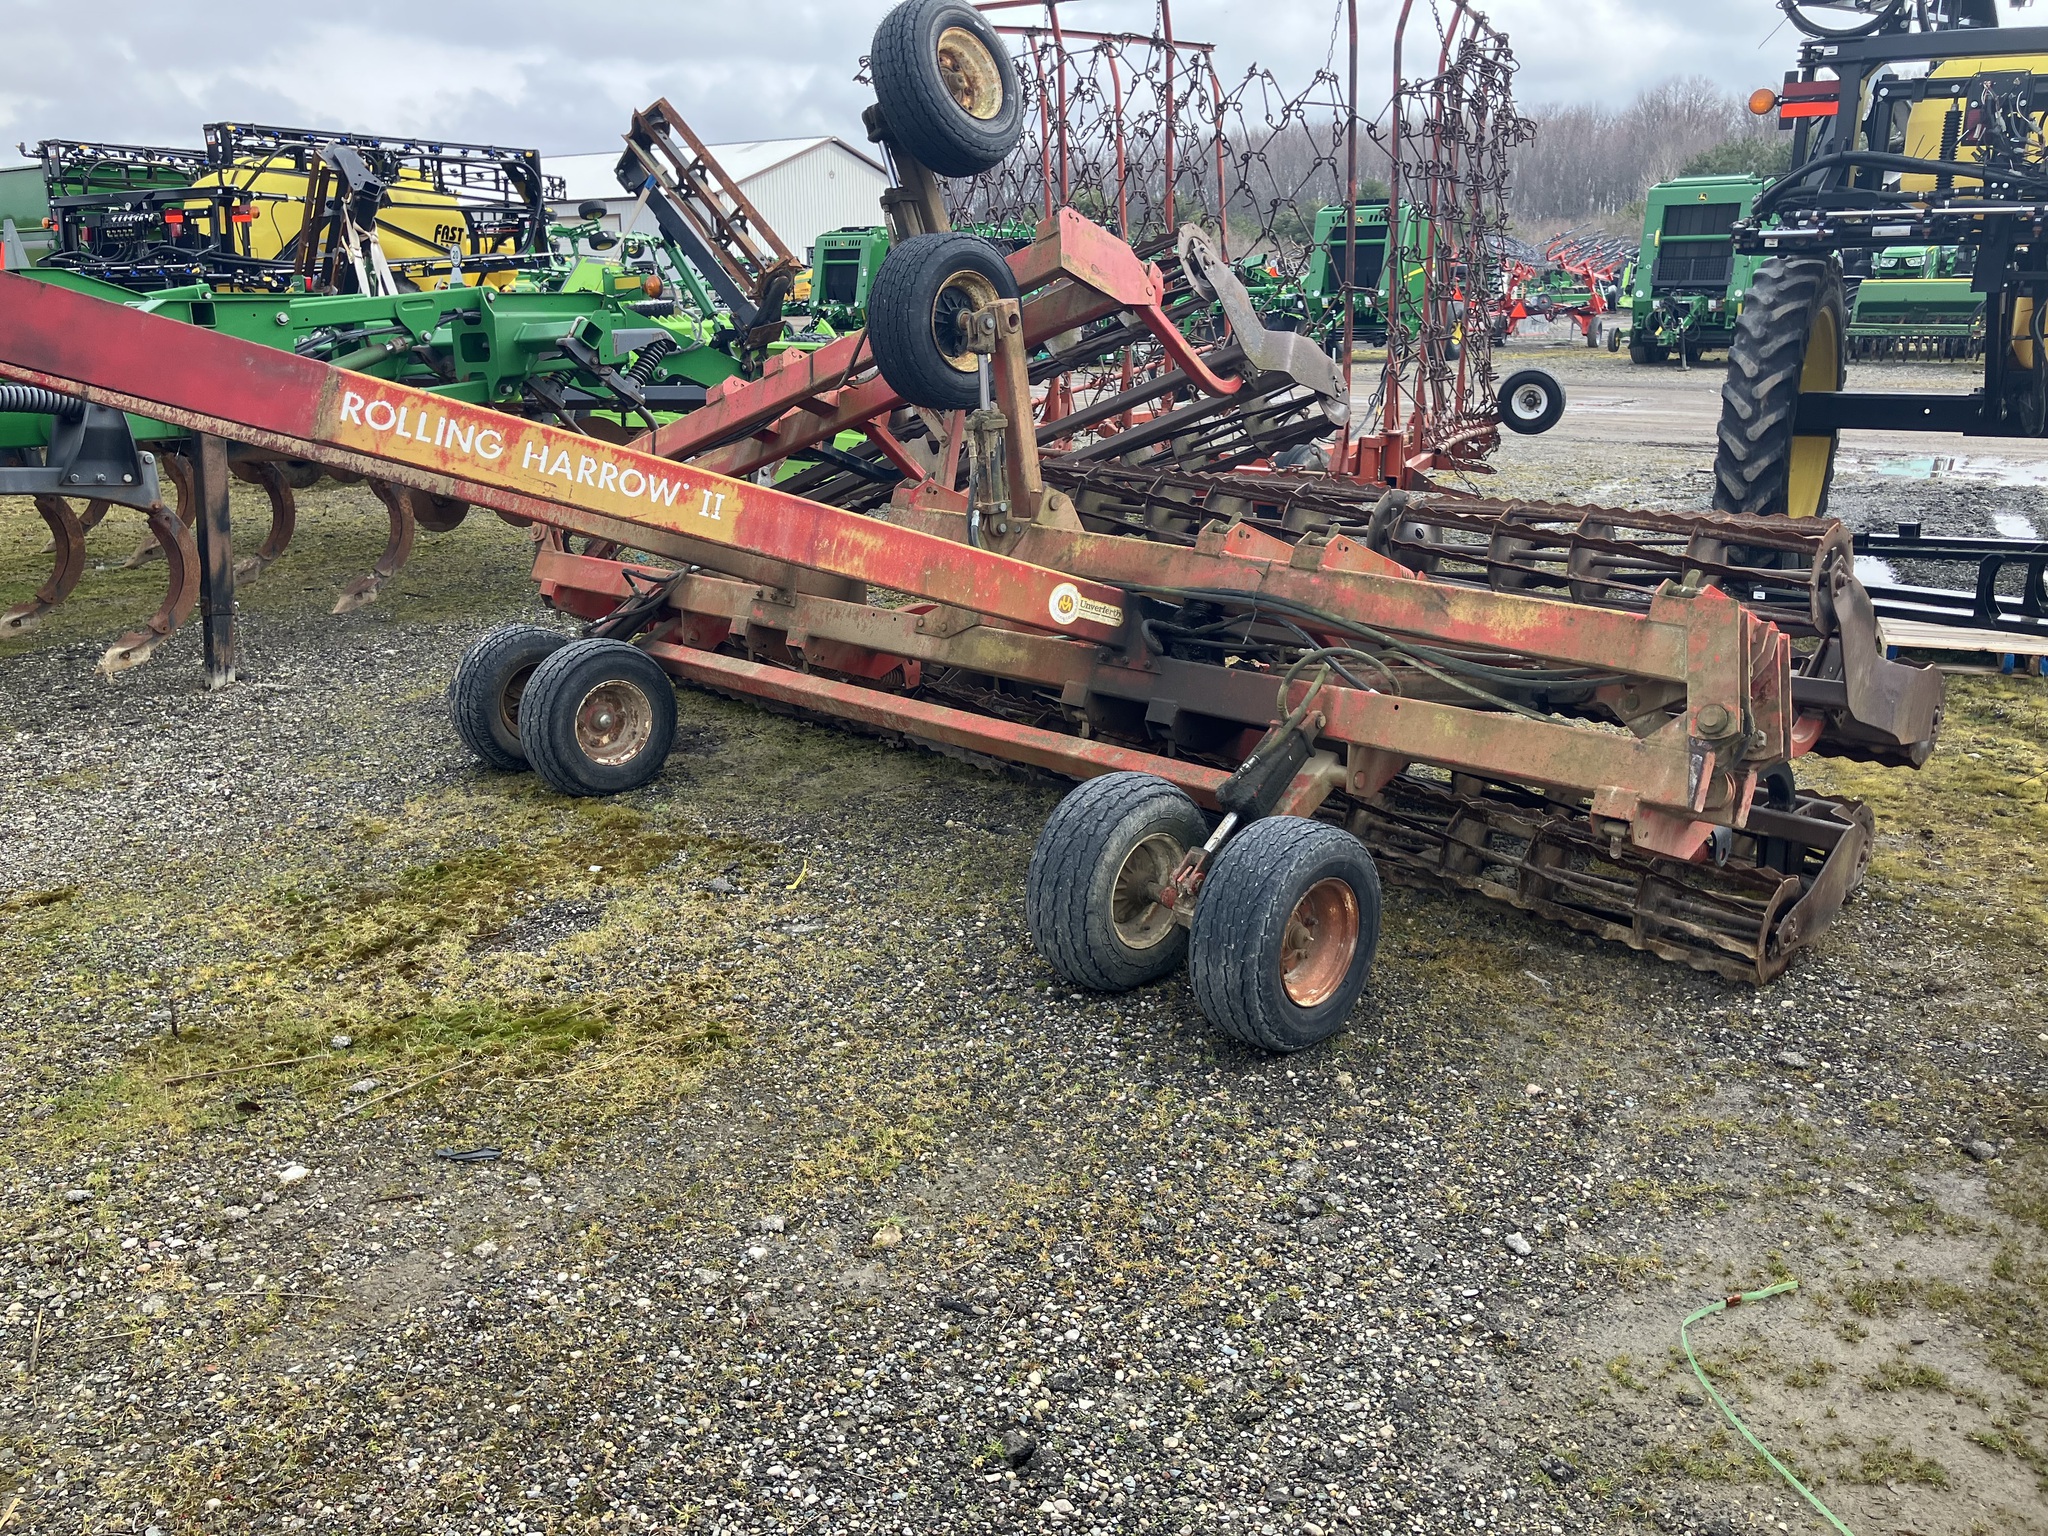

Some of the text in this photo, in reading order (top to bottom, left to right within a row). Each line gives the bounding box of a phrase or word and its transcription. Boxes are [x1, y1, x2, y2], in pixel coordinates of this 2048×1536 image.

[434, 223, 464, 243] FAST
[340, 391, 726, 520] ROLLING HARROW II
[1080, 600, 1121, 617] Unverferth
